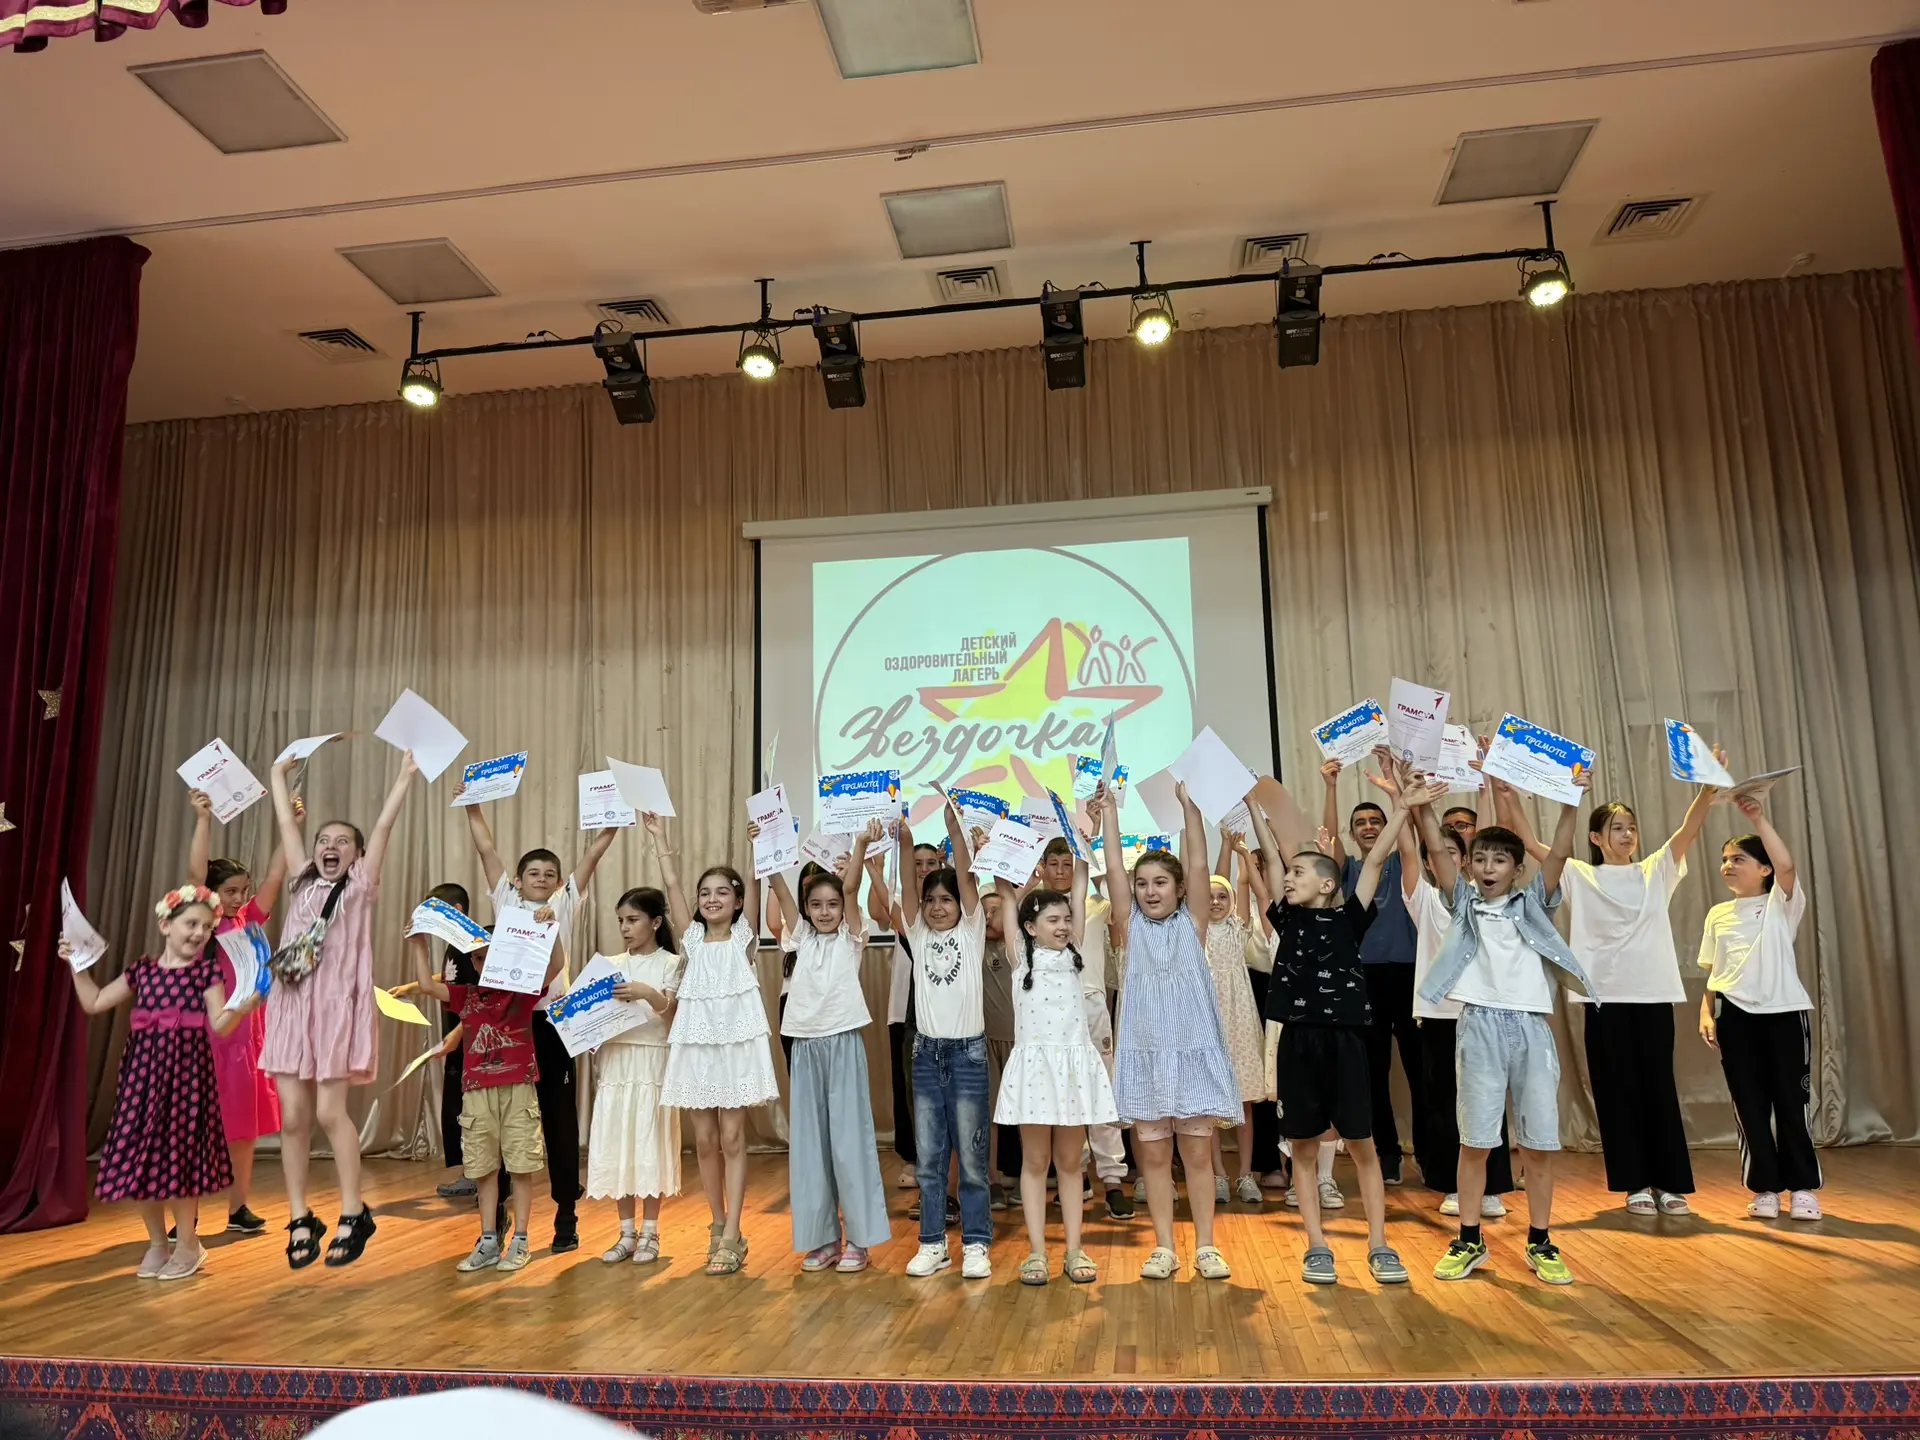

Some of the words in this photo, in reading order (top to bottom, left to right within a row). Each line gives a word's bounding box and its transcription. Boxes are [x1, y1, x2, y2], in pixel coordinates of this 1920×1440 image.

[960, 632, 1017, 652] ДЕТСКИЙ
[884, 648, 1008, 671] ОЗДОРОВИТЕЛЬНЫЙ
[952, 666, 1000, 683] ЛАГЕРЬ
[831, 694, 1104, 788] Звездочка
